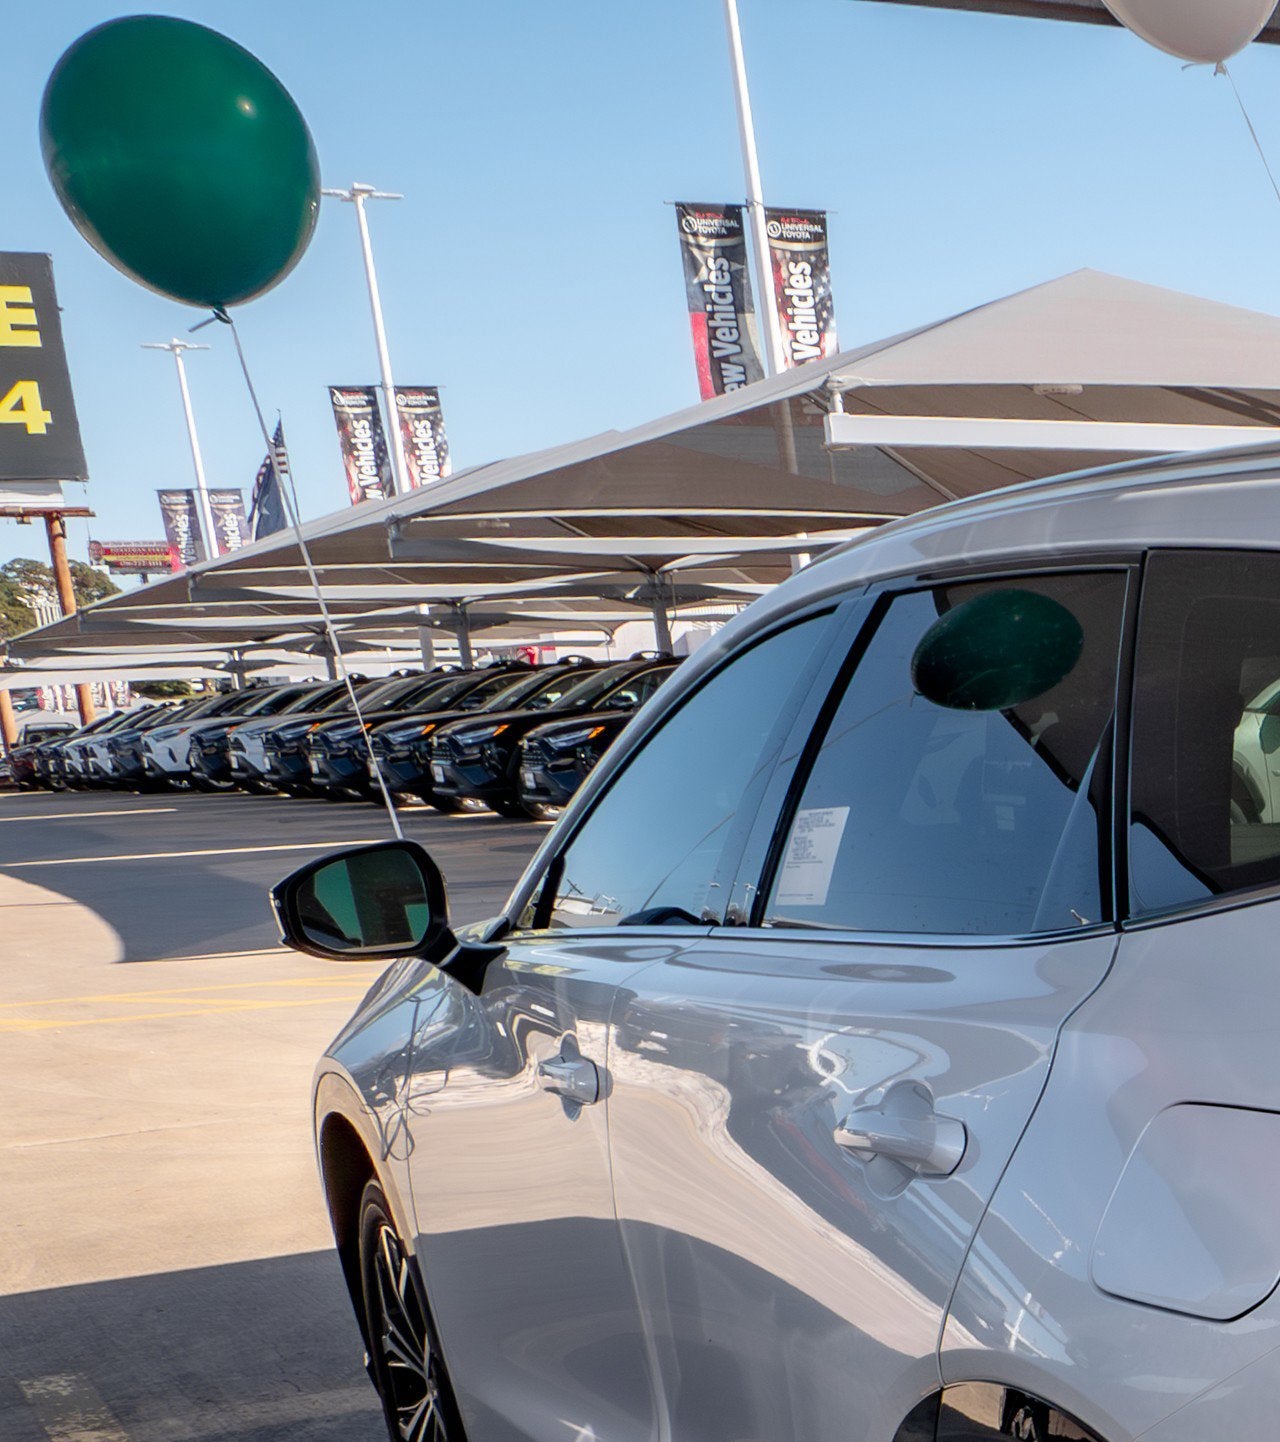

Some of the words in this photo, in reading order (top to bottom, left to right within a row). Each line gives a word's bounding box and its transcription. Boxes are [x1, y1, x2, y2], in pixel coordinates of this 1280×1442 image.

[781, 223, 823, 233] UNIVERSAL
[781, 230, 811, 240] TOYOTA
[703, 256, 743, 359] Vehicles
[784, 260, 823, 361] Vehicles
[350, 419, 380, 487] Vehicles
[412, 419, 442, 486] Vehicles
